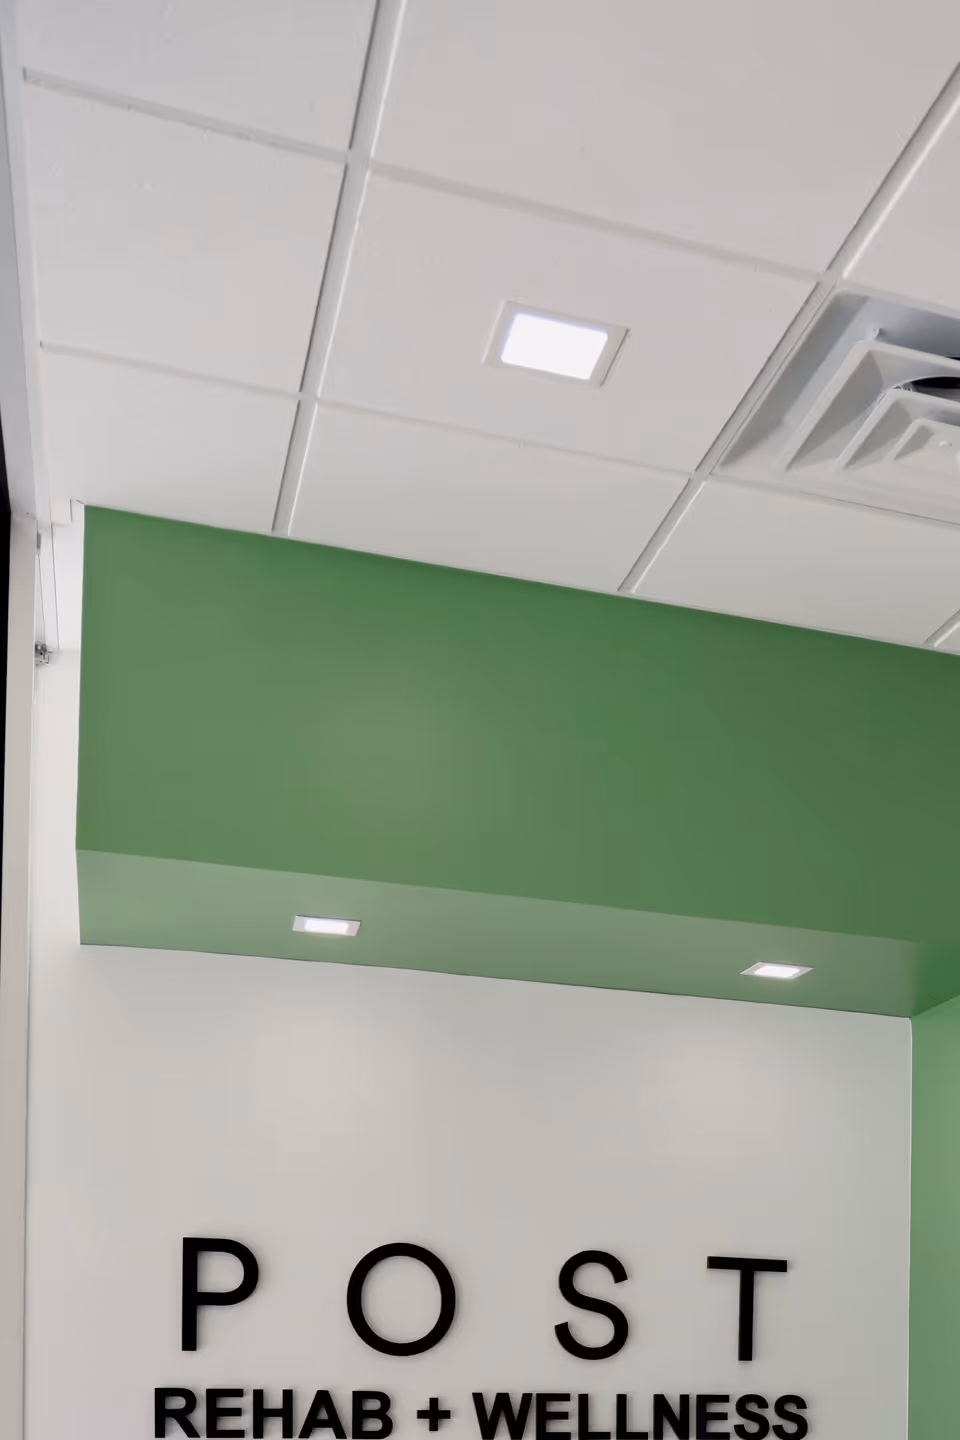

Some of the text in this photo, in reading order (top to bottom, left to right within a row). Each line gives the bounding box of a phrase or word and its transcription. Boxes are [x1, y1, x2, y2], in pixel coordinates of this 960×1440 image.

[181, 1237, 788, 1361] POST
[153, 1387, 809, 1440] REHAB + WELLNESS
